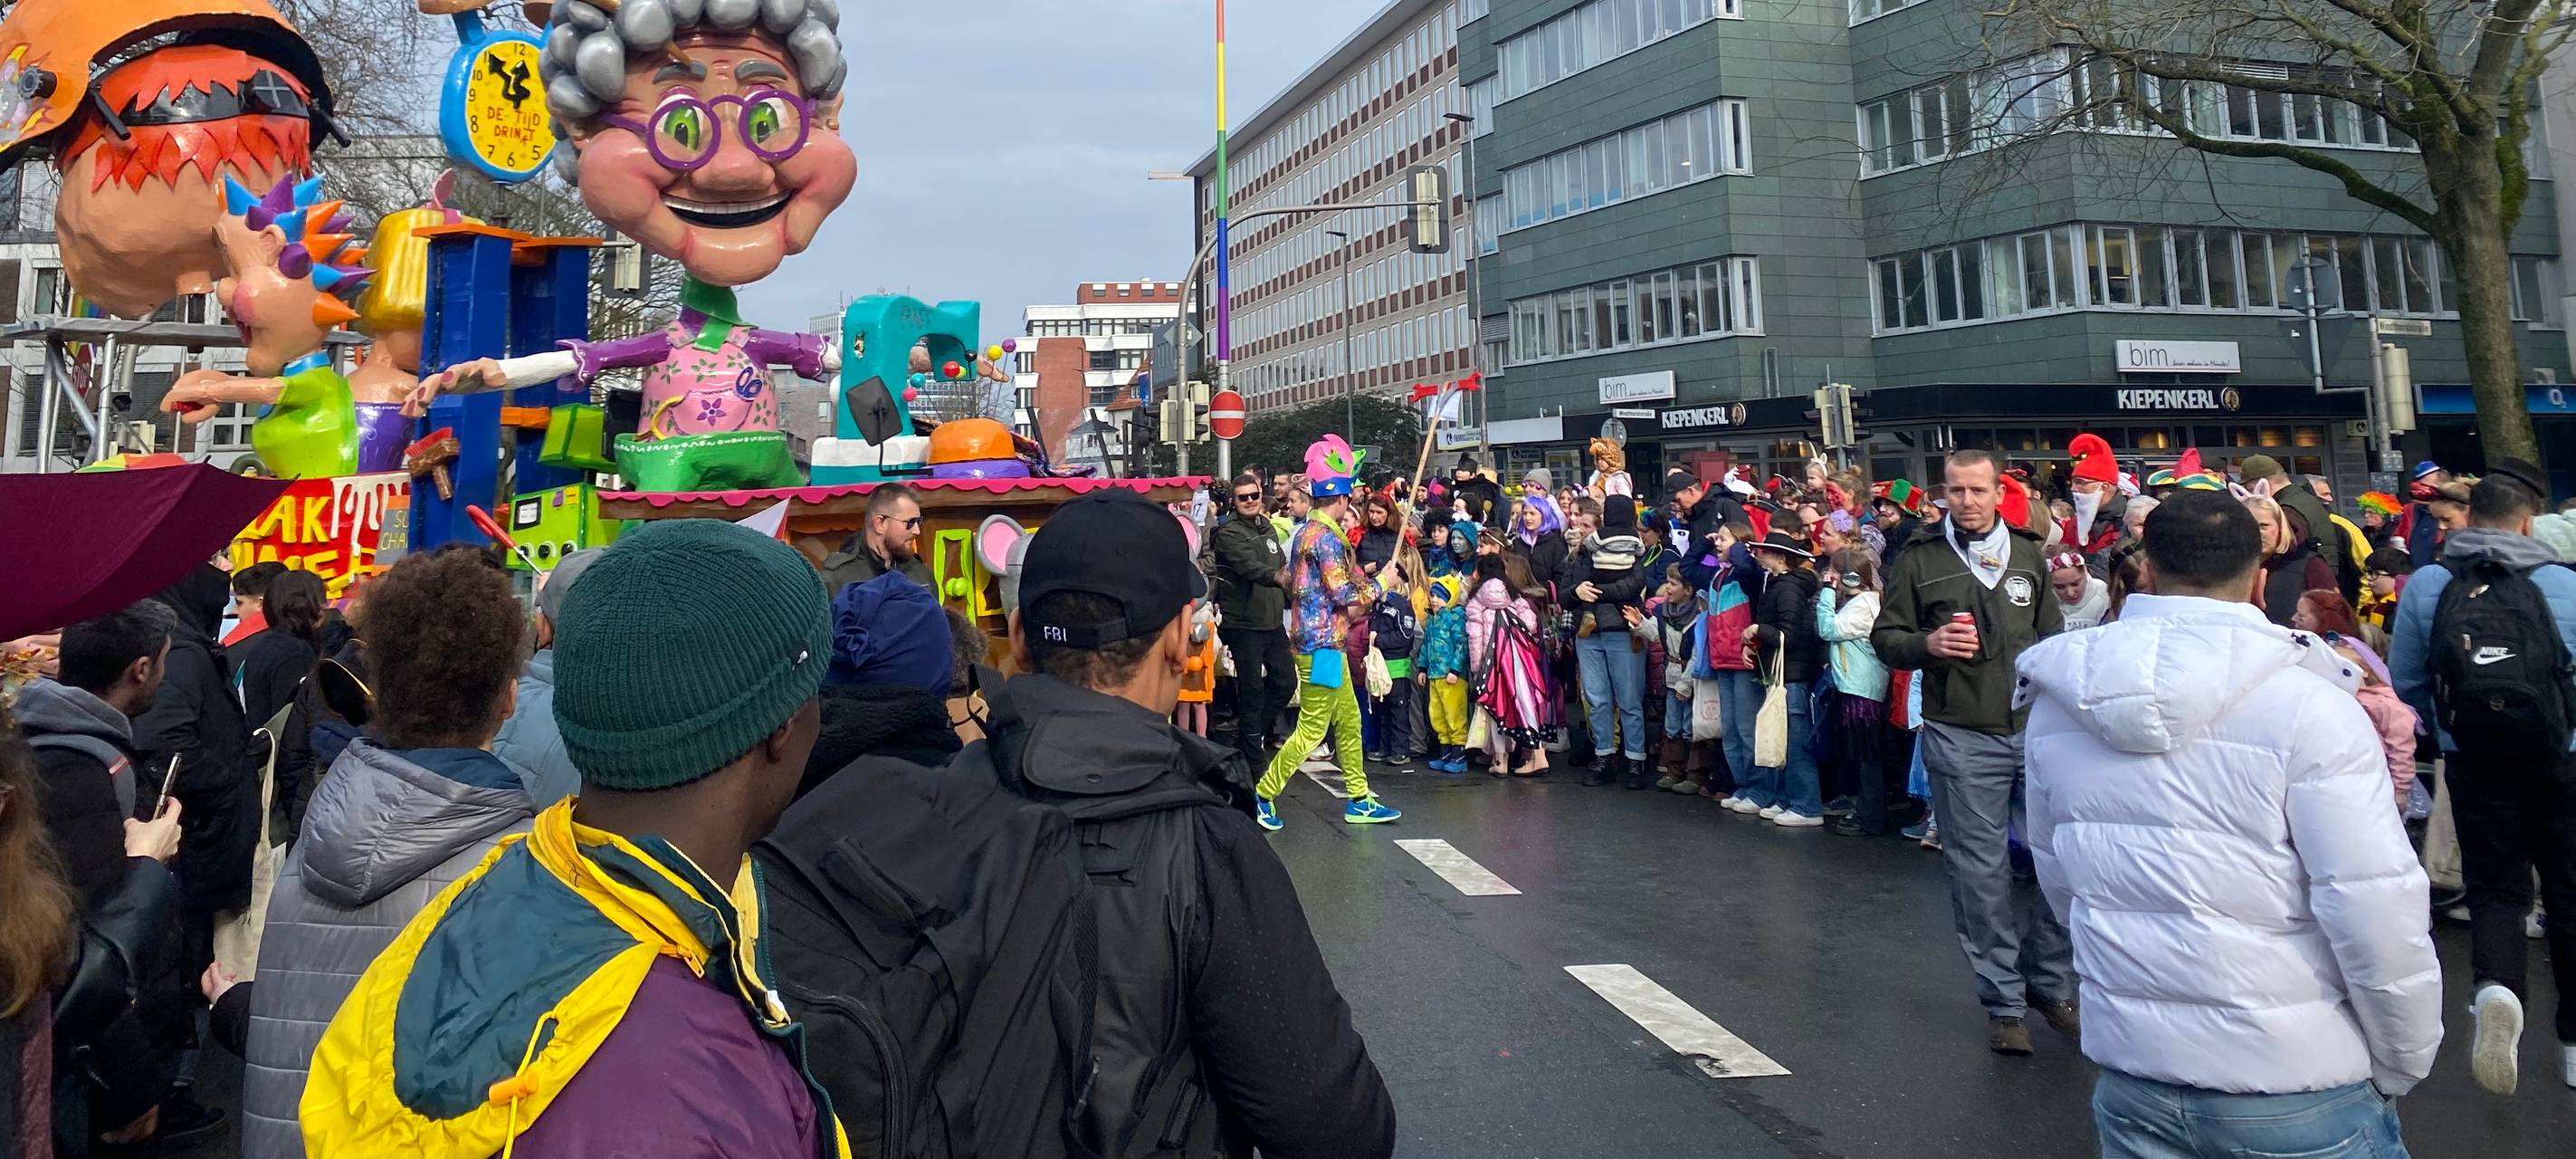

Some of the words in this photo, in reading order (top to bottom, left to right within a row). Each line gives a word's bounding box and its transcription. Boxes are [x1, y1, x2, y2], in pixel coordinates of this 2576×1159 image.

[513, 43, 526, 56] 12
[472, 69, 482, 81] 10
[468, 89, 476, 101] 9
[487, 106, 504, 120] DE
[471, 115, 479, 133] 8
[487, 145, 495, 158] 7
[507, 151, 515, 167] 6
[531, 145, 542, 160] 5
[2130, 342, 2168, 367] bim
[1604, 378, 1627, 399] bim
[2117, 389, 2219, 409] KIEPENKERL
[1662, 407, 1730, 428] KIEPENKERL
[1192, 503, 1203, 517] 17
[380, 532, 408, 551] CHA
[1044, 626, 1067, 643] FBI
[2480, 647, 2509, 656] NIKE
